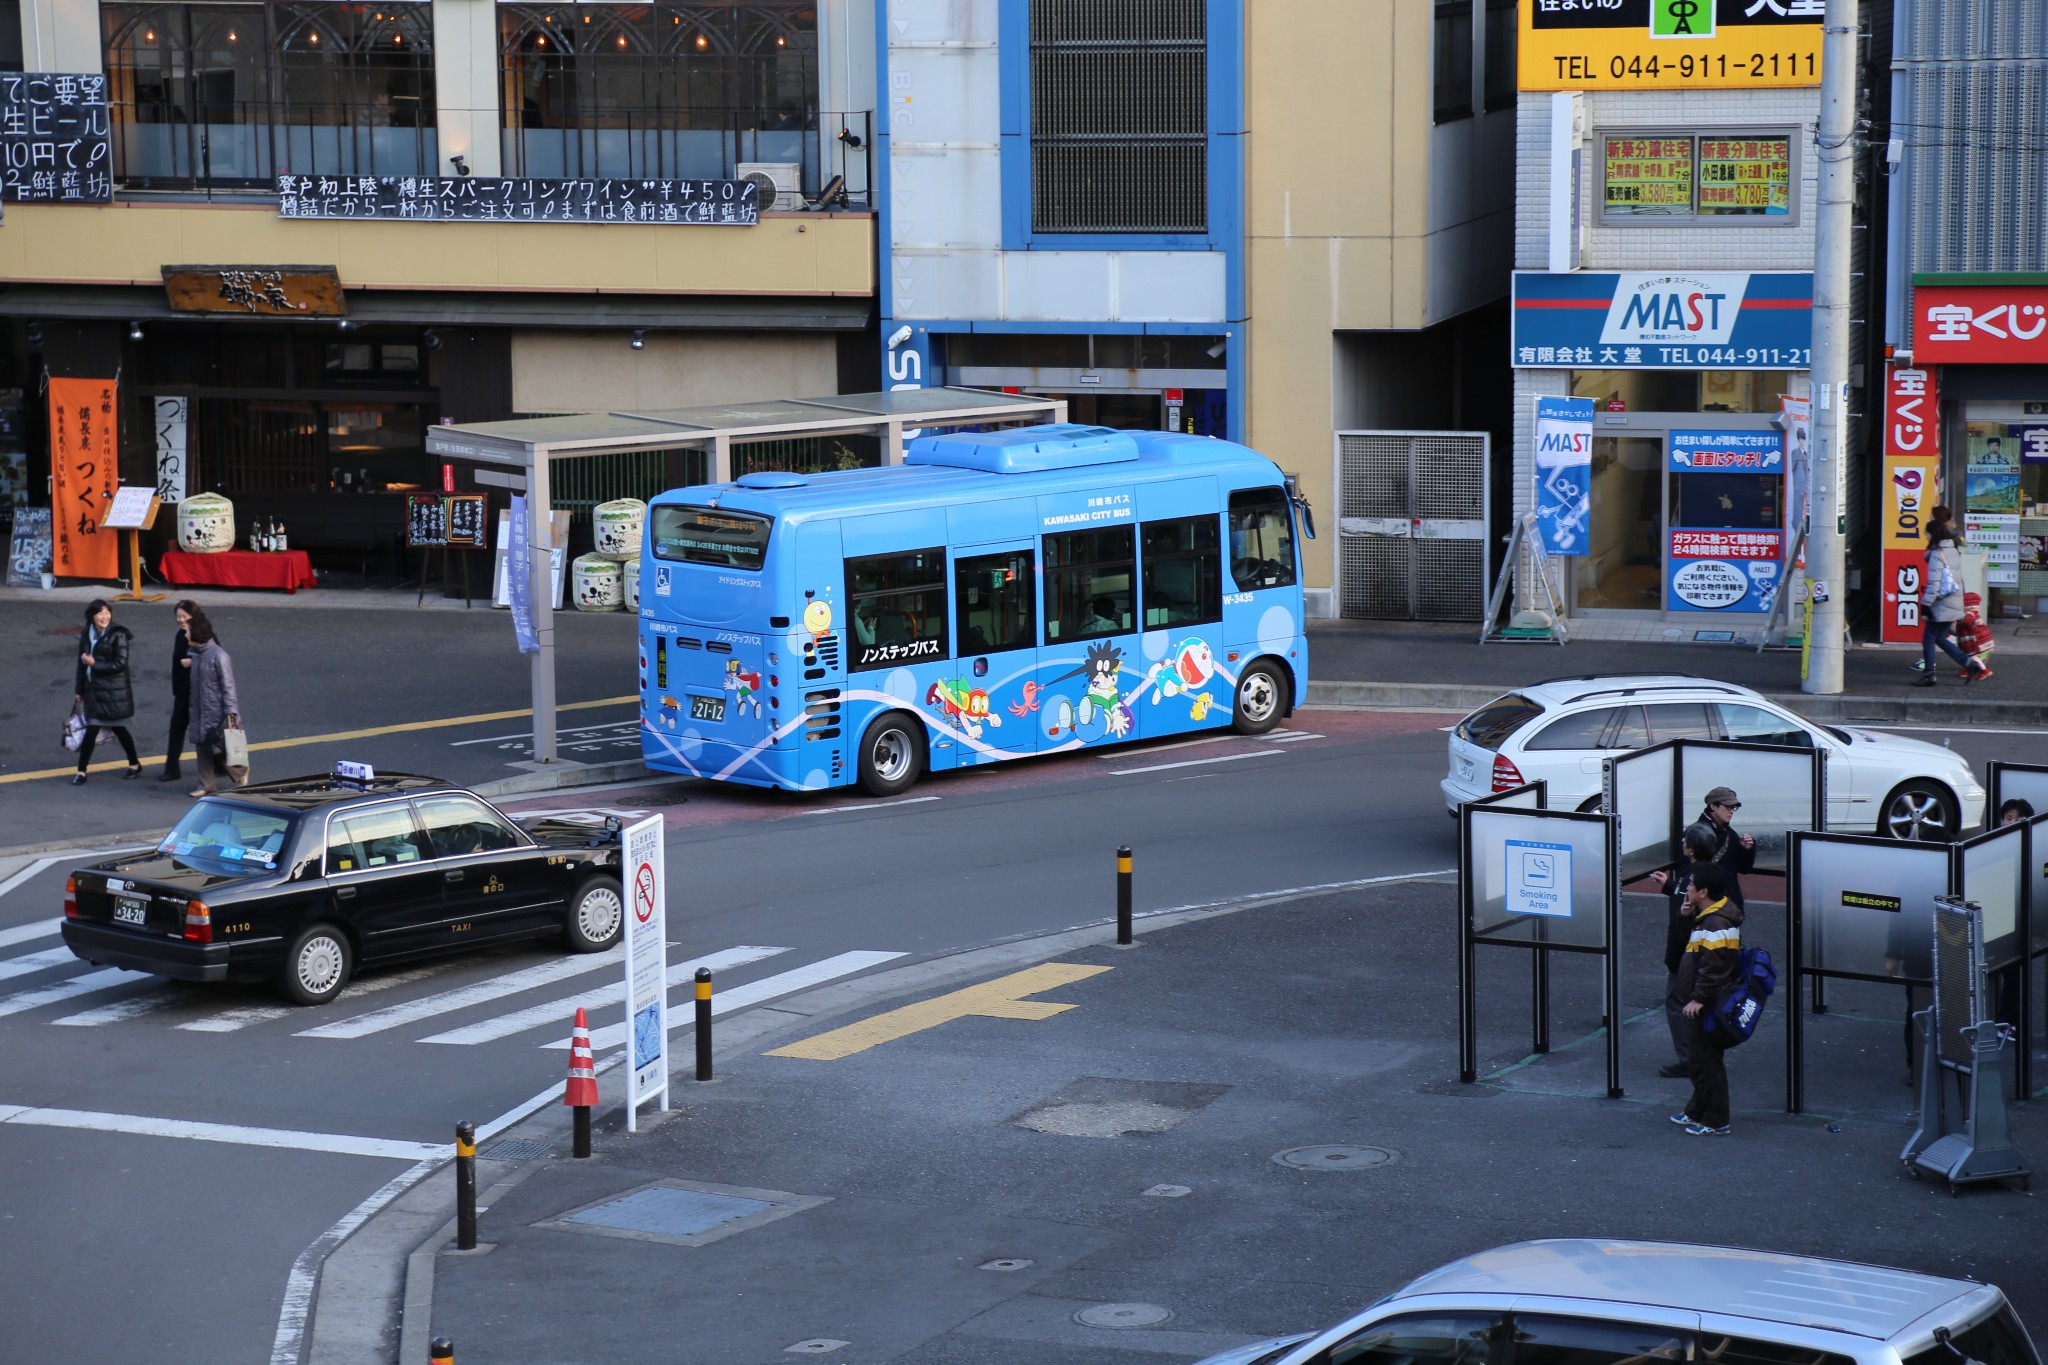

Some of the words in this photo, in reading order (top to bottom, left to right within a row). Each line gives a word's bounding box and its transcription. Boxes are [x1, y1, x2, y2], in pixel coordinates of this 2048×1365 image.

[1554, 56, 1597, 79] TEL
[1610, 52, 1816, 79] 044-911-2111
[0, 106, 107, 135] 生ビール
[1607, 141, 1691, 159] 新築分譲住宅
[1702, 142, 1788, 160] 新築分譲住宅
[1620, 292, 1726, 332] MAST
[1928, 304, 2047, 341] 宝くじ
[1519, 346, 1593, 364] 有限会社
[1659, 348, 1693, 364] TEL
[1697, 347, 1811, 365] 044-911-21
[1893, 368, 1927, 451] 宝くじ
[157, 399, 181, 502] つくね祭
[1540, 432, 1591, 452] MAST
[1692, 451, 1761, 467] 画面にタッチ!
[76, 462, 97, 536] つくね
[1044, 512, 1090, 527] KAWASAKI
[1091, 509, 1111, 521] CITY
[1113, 507, 1131, 519] BUS
[1896, 497, 1920, 540] LOTO
[1696, 564, 1726, 572] お気軽に
[1753, 566, 1771, 574] MAST
[1683, 573, 1739, 582] ご利用ください。
[1677, 583, 1744, 591] 気になる物件情報を
[1222, 592, 1254, 605] W-3435
[1686, 592, 1735, 601] 印刷できます。
[1897, 565, 1921, 628] BIG
[641, 608, 655, 618] 3435
[716, 632, 762, 645] ノンステップバス
[861, 640, 940, 664] ノンステップバス
[696, 702, 724, 721] 21-12
[1519, 889, 1558, 902] Smoking
[121, 906, 145, 922] 34-20
[1528, 900, 1549, 910] Area
[224, 922, 251, 934] 4110
[451, 923, 472, 933] TAXI
